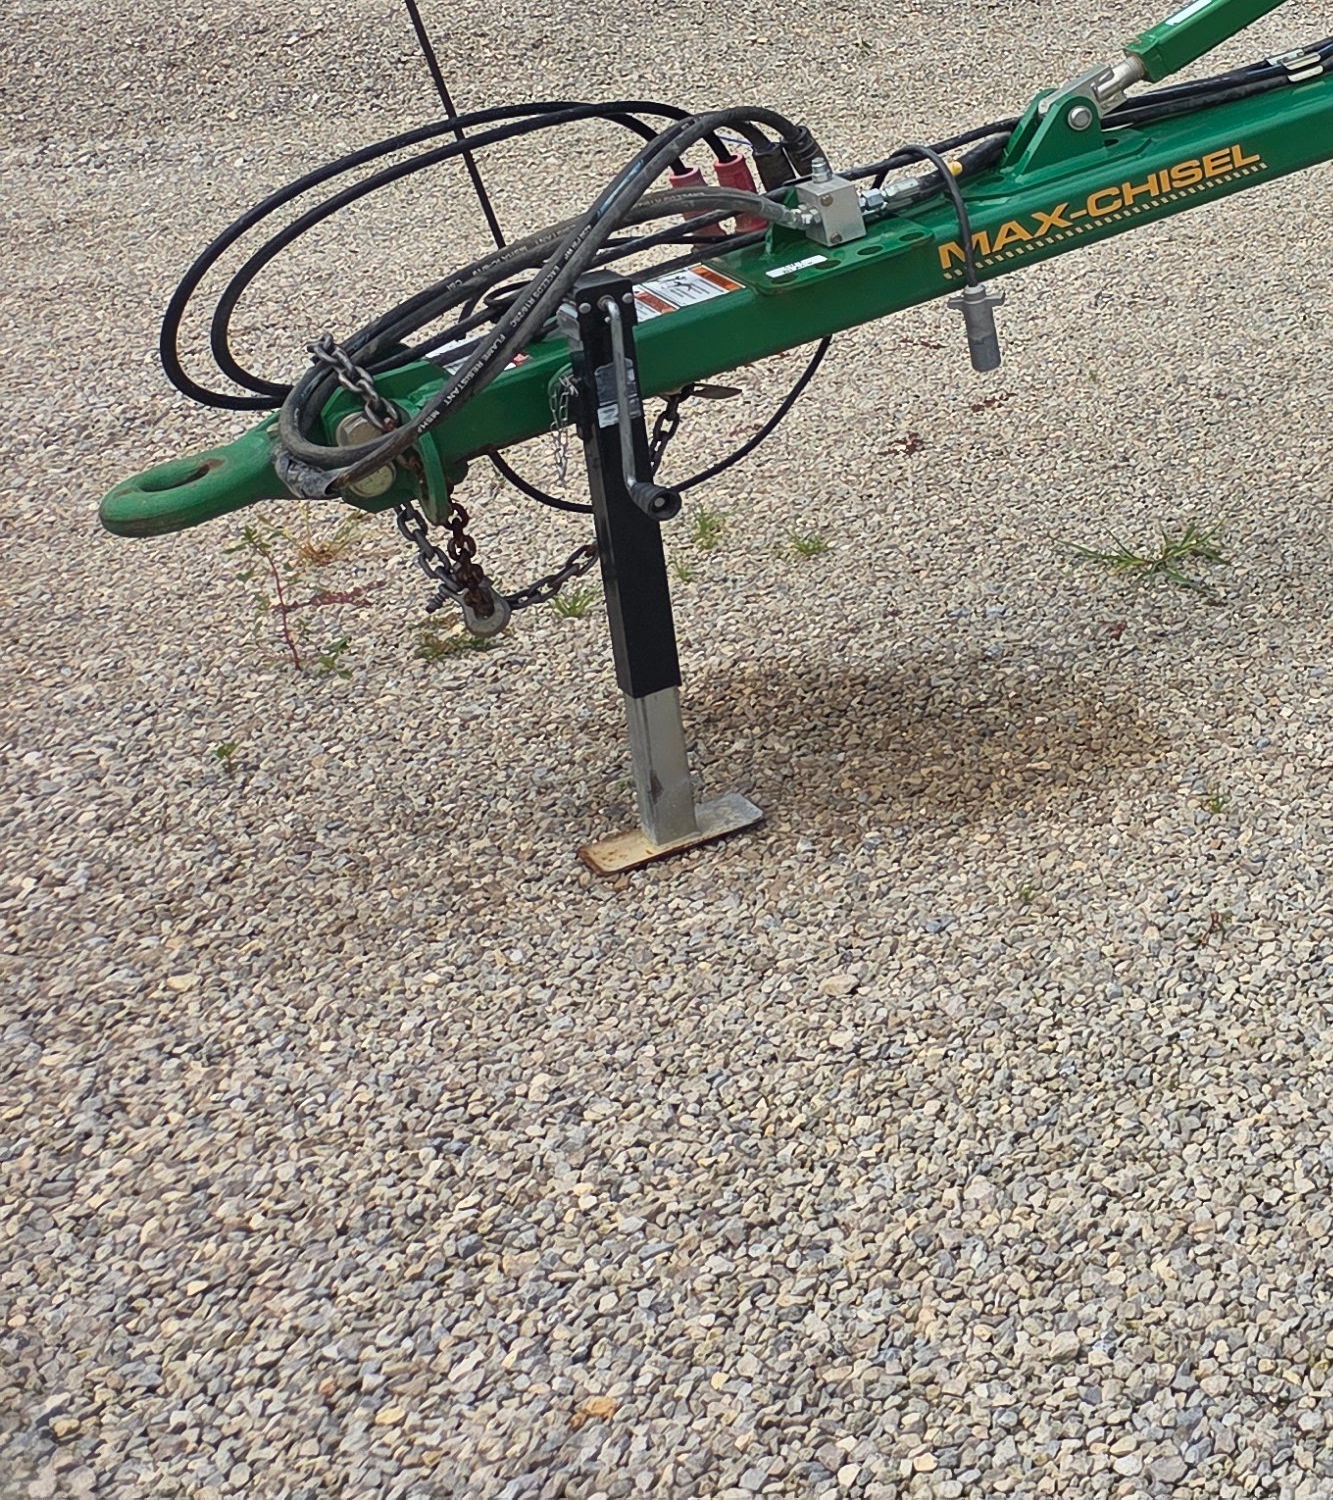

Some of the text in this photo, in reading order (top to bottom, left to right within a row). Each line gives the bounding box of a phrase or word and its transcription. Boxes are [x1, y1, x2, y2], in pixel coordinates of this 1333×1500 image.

[938, 144, 1261, 270] MAX-CHISEL
[481, 334, 506, 362] FLAME
[443, 360, 484, 405] RESISTANT
